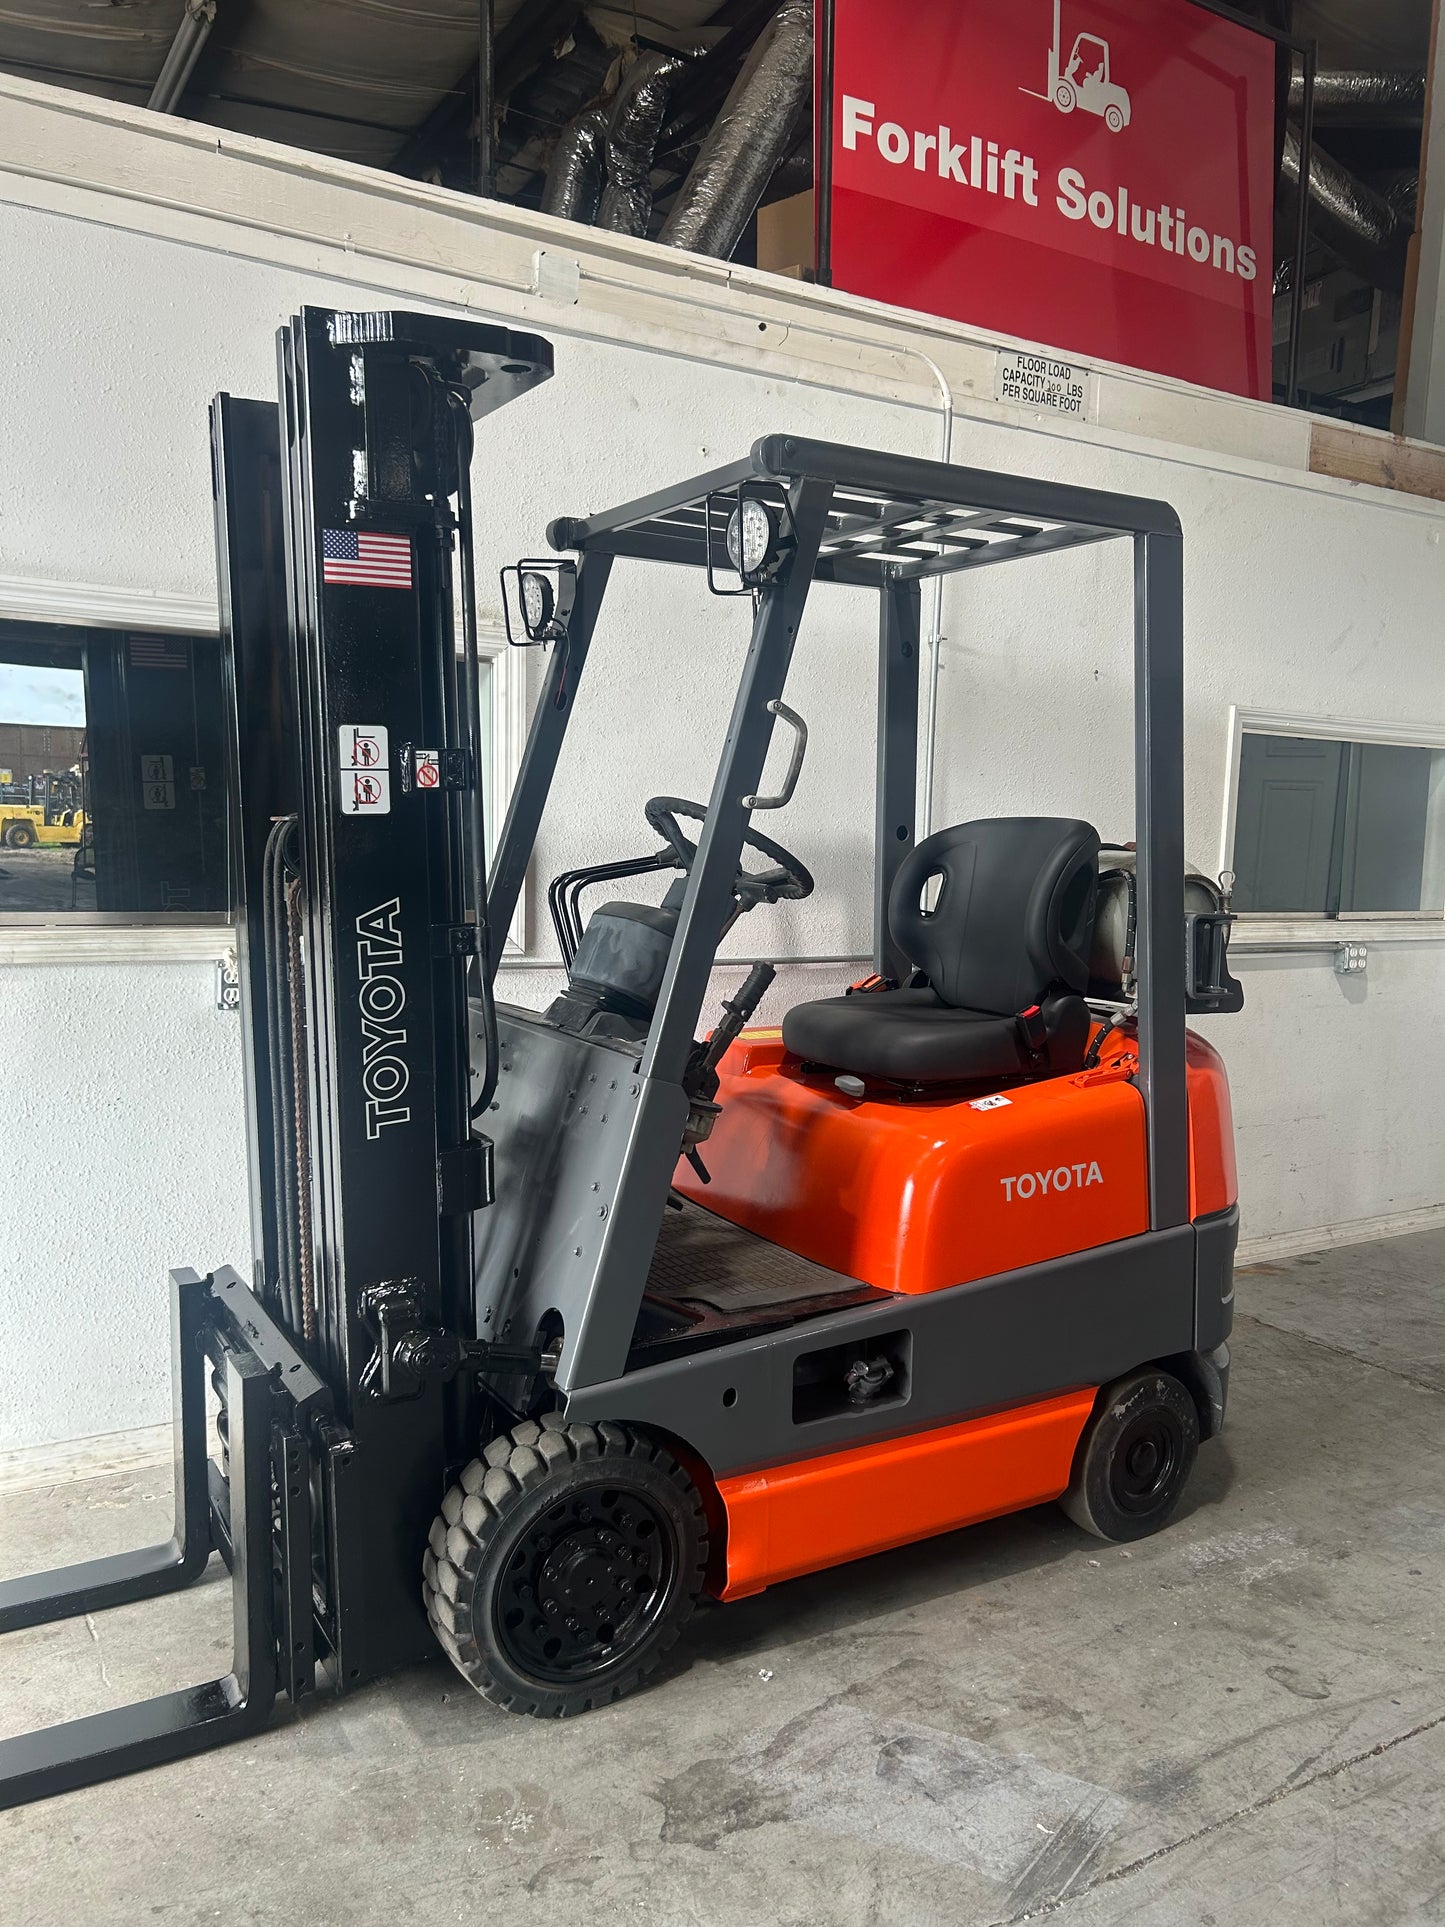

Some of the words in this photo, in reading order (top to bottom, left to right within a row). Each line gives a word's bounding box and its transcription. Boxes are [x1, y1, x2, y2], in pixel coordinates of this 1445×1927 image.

[842, 94, 1039, 207] Forklift
[1056, 167, 1257, 281] Solutions
[1002, 368, 1046, 388] CAPACITY
[1067, 382, 1083, 398] LBS
[1017, 356, 1046, 374] FLOOR
[1048, 364, 1071, 380] LOAD
[1002, 383, 1020, 398] PER
[1022, 387, 1057, 407] SQUARE
[1059, 396, 1081, 412] FOOT
[355, 896, 411, 1141] TOYOTA
[1000, 1161, 1104, 1202] TOYOTA
